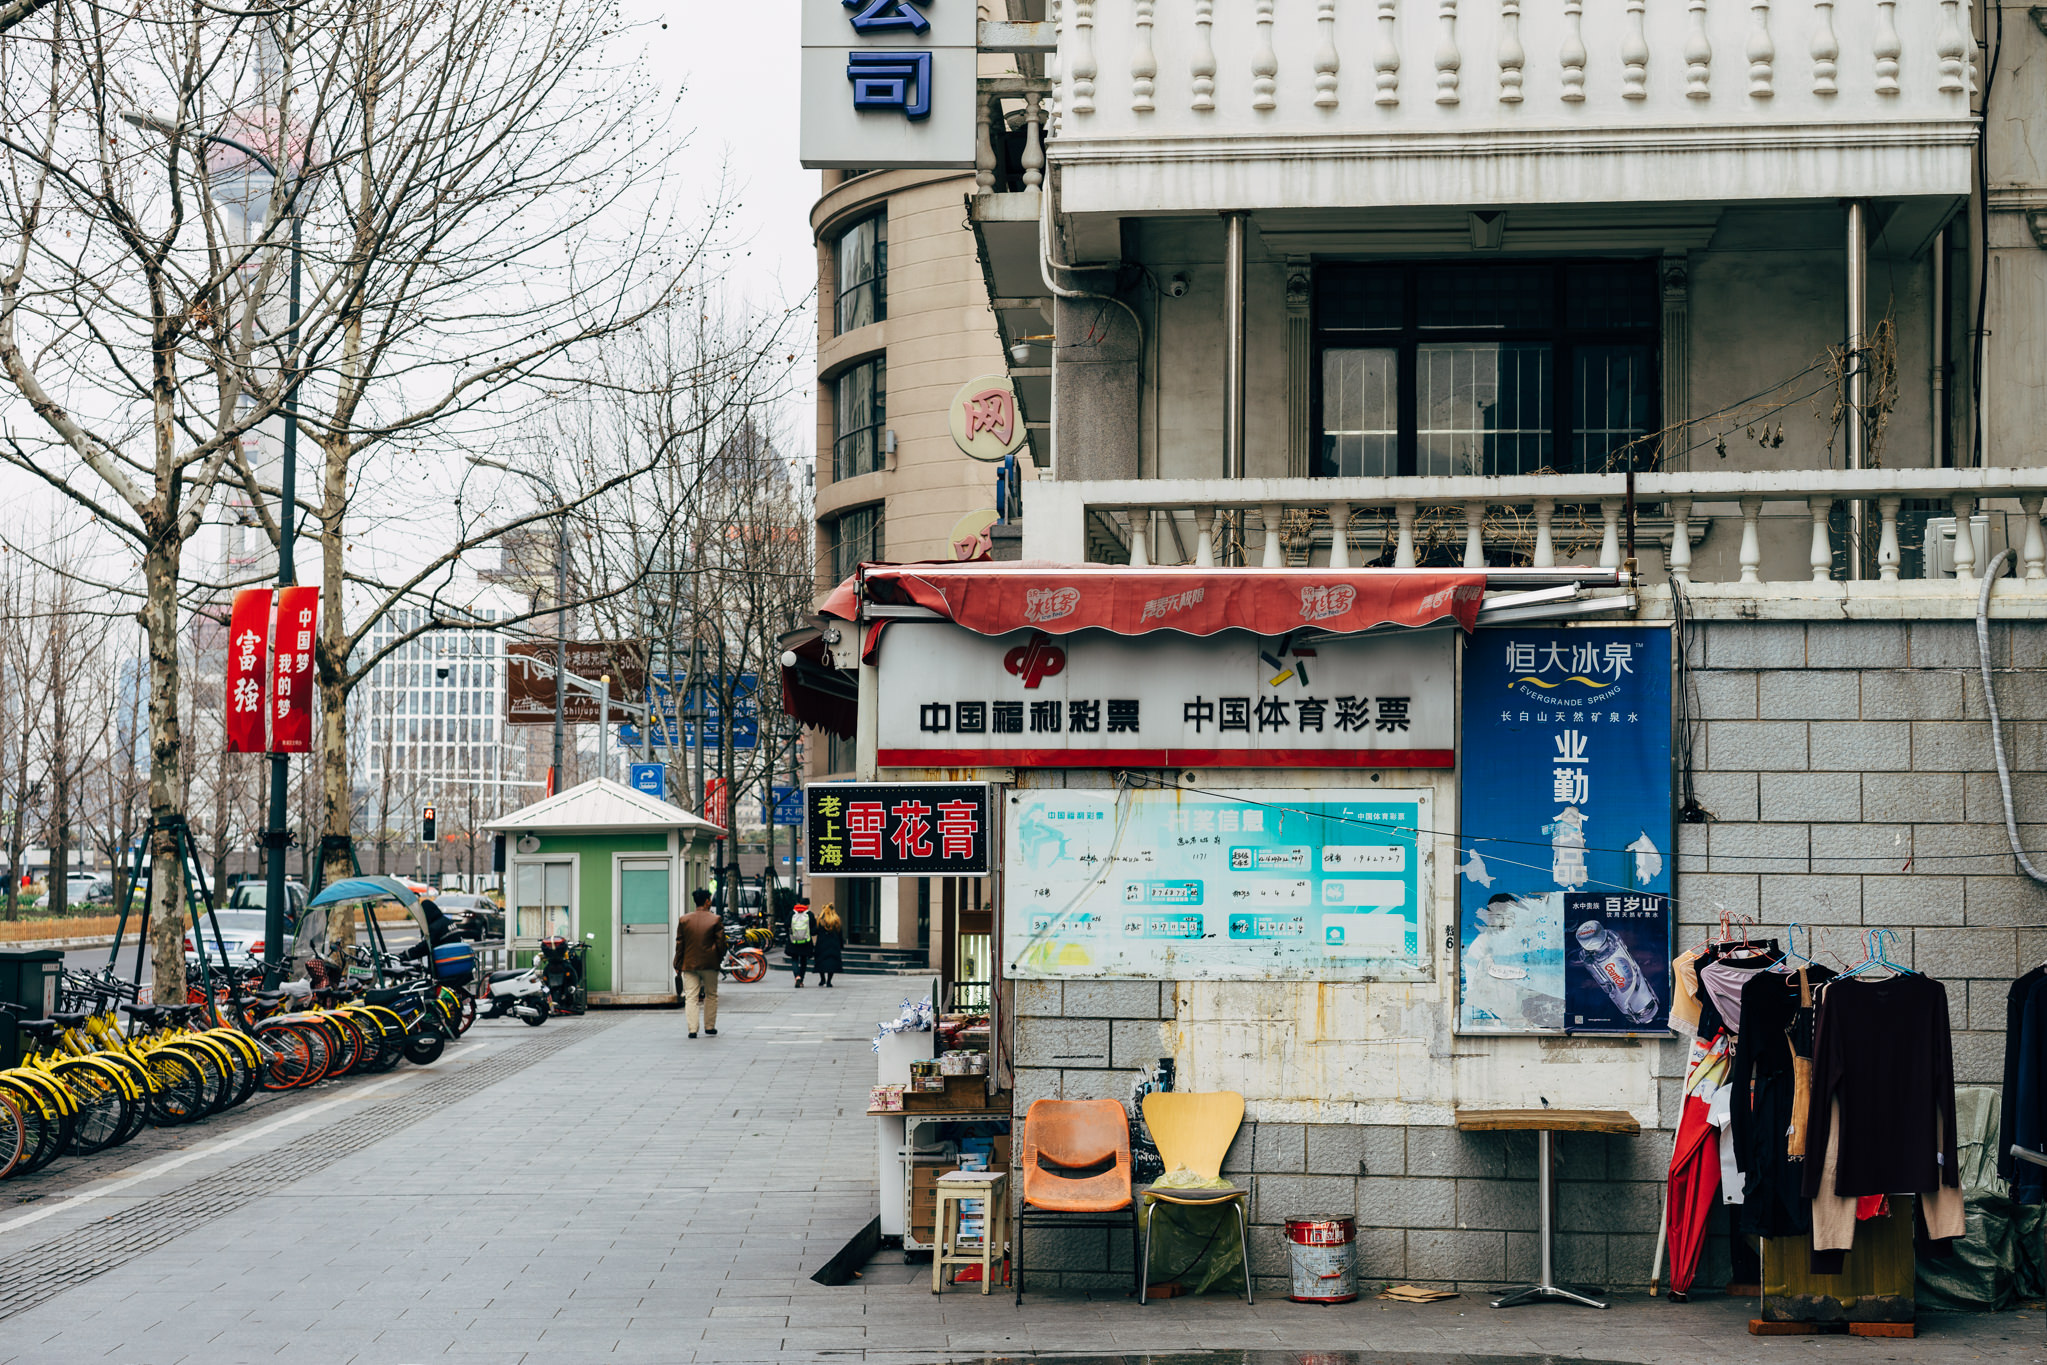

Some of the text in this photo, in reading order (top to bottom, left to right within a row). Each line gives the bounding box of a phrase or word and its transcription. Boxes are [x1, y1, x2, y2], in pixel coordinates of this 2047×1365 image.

[296, 608, 312, 673] 中国梦
[1506, 640, 1634, 681] 恒大冰泉
[278, 653, 292, 719] 我的梦
[1519, 684, 1621, 706] EVERGRANDE SPRING
[920, 700, 1140, 734] 中国福利彩票
[1183, 695, 1411, 733] 中国体育彩票
[1501, 710, 1639, 723] 长白山天然矿泉水
[818, 795, 843, 866] 老上海
[846, 799, 978, 860] 雪花膏
[1048, 811, 1104, 820] 中国福利彩票
[1168, 809, 1264, 832] 开奖信息
[1357, 812, 1405, 821] 中国体育彩票
[1572, 896, 1659, 912] 水中贵族 百岁山
